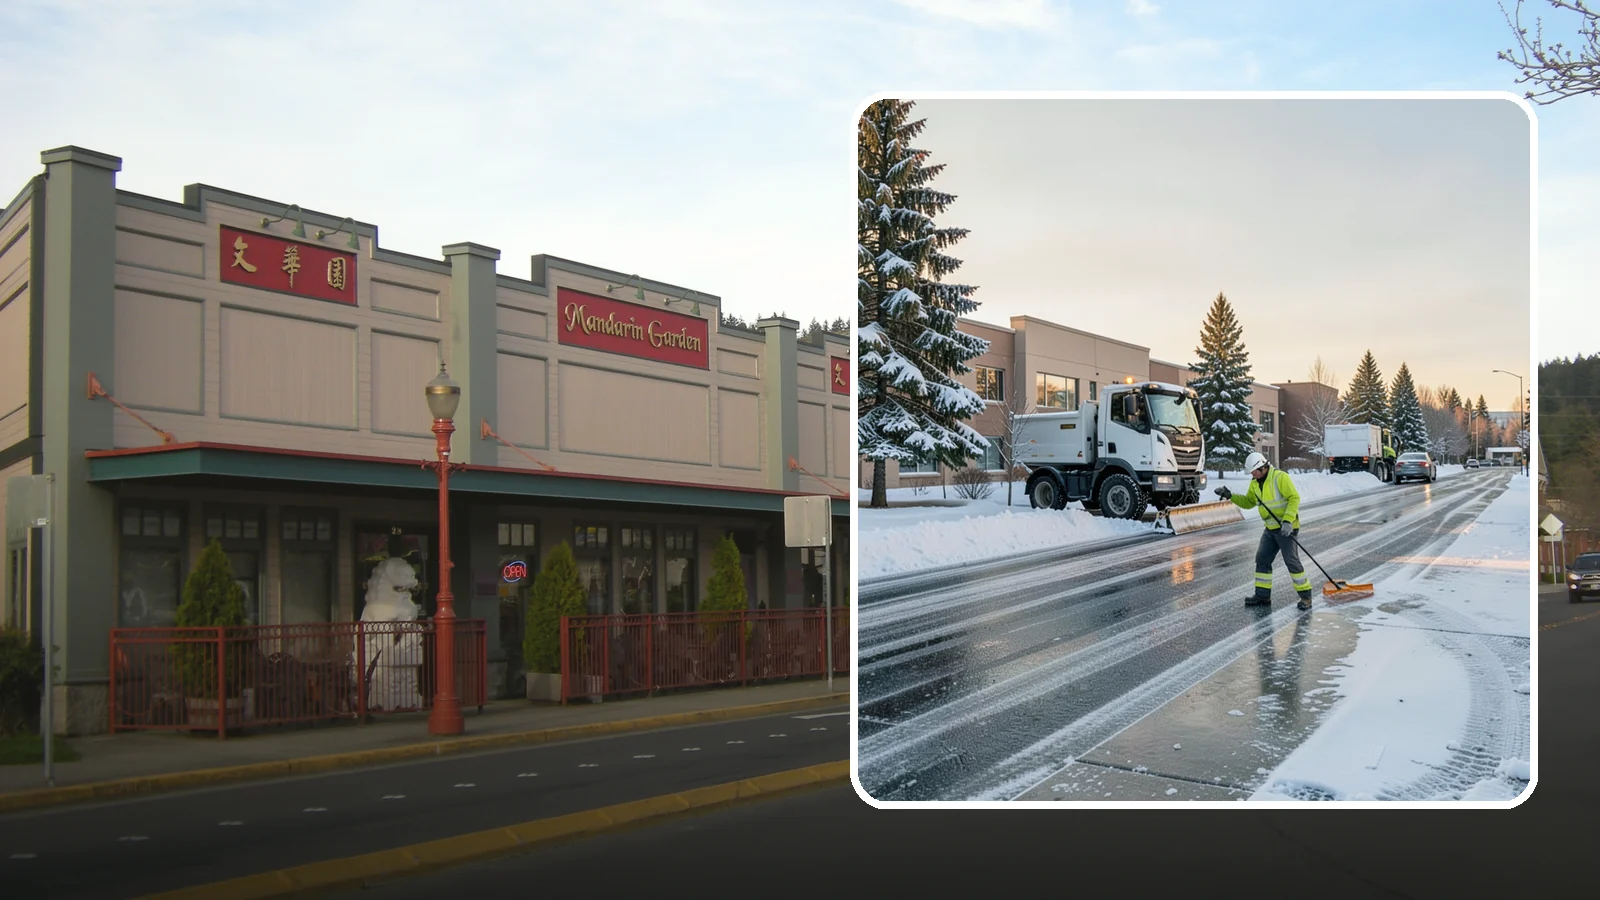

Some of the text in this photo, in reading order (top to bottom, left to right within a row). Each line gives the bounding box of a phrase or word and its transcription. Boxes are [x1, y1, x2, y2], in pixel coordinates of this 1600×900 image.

[231, 236, 346, 290] 文華園
[564, 302, 702, 352] Mandarin Garden
[834, 363, 847, 386] 文
[503, 565, 527, 578] OPEN
